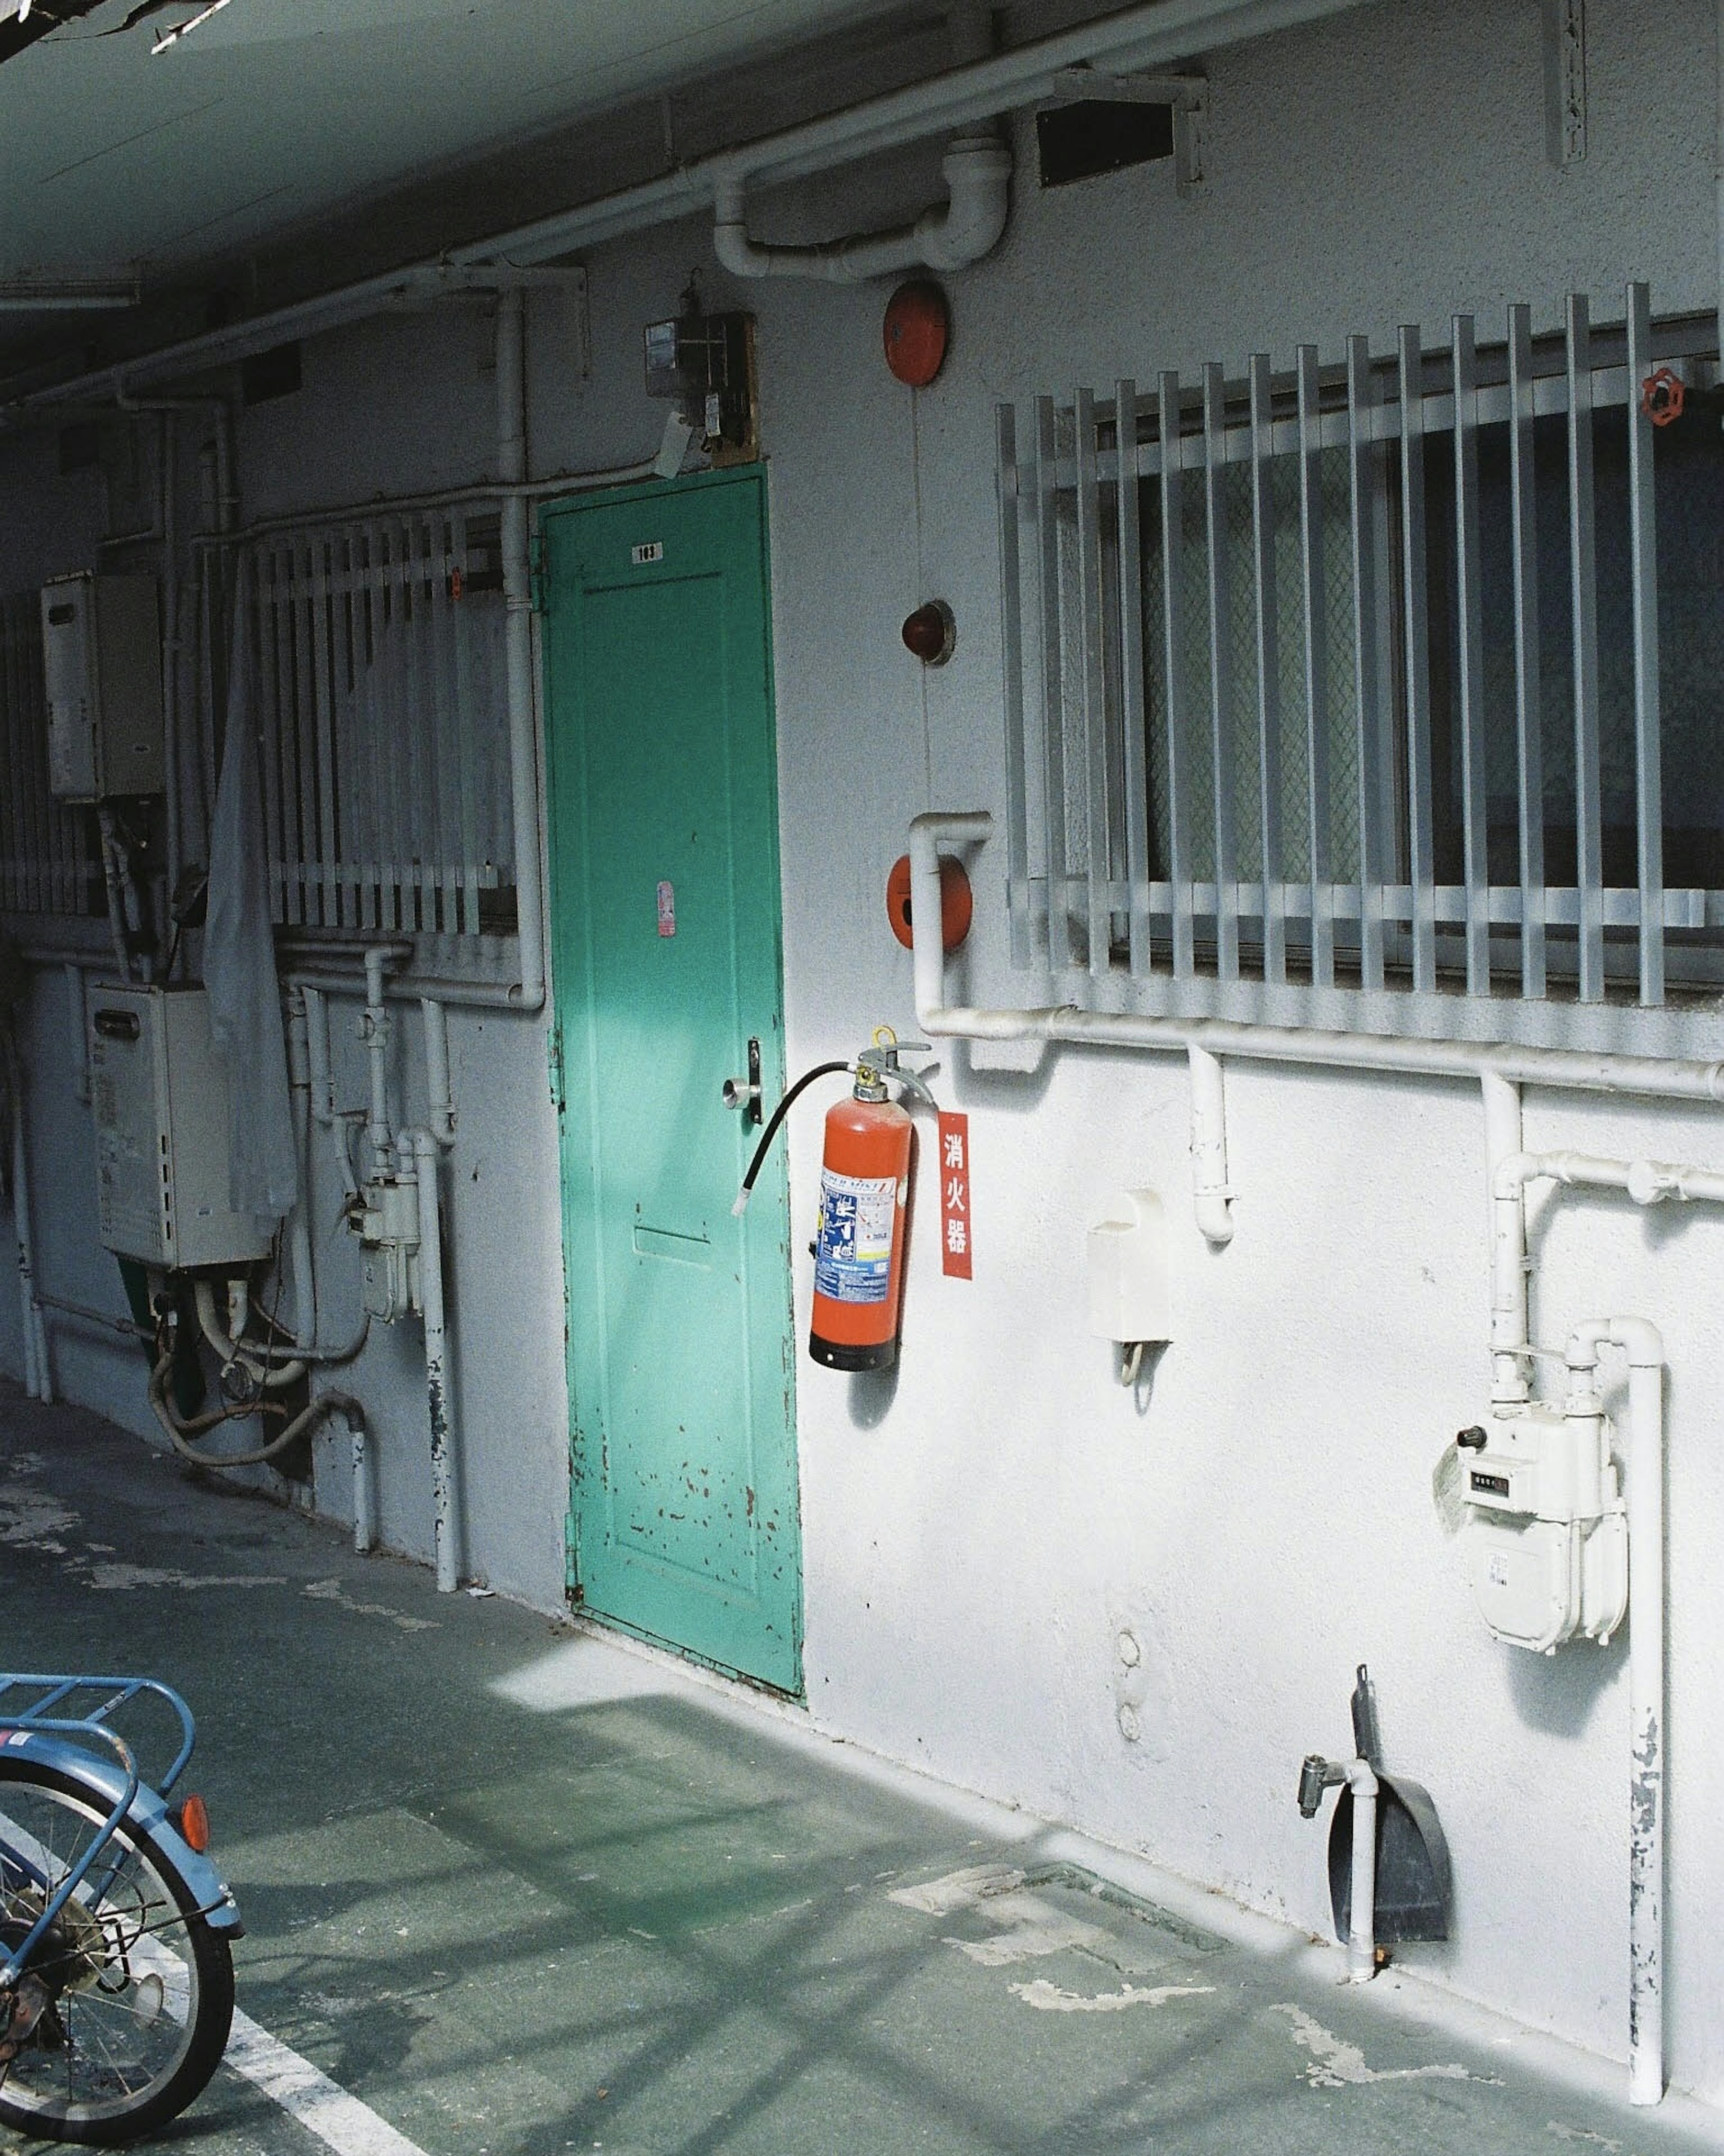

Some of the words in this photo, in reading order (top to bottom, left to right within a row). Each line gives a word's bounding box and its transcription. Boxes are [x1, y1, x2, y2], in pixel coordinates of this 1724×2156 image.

[639, 545, 654, 560] 103
[944, 1133, 966, 1254] 消火器
